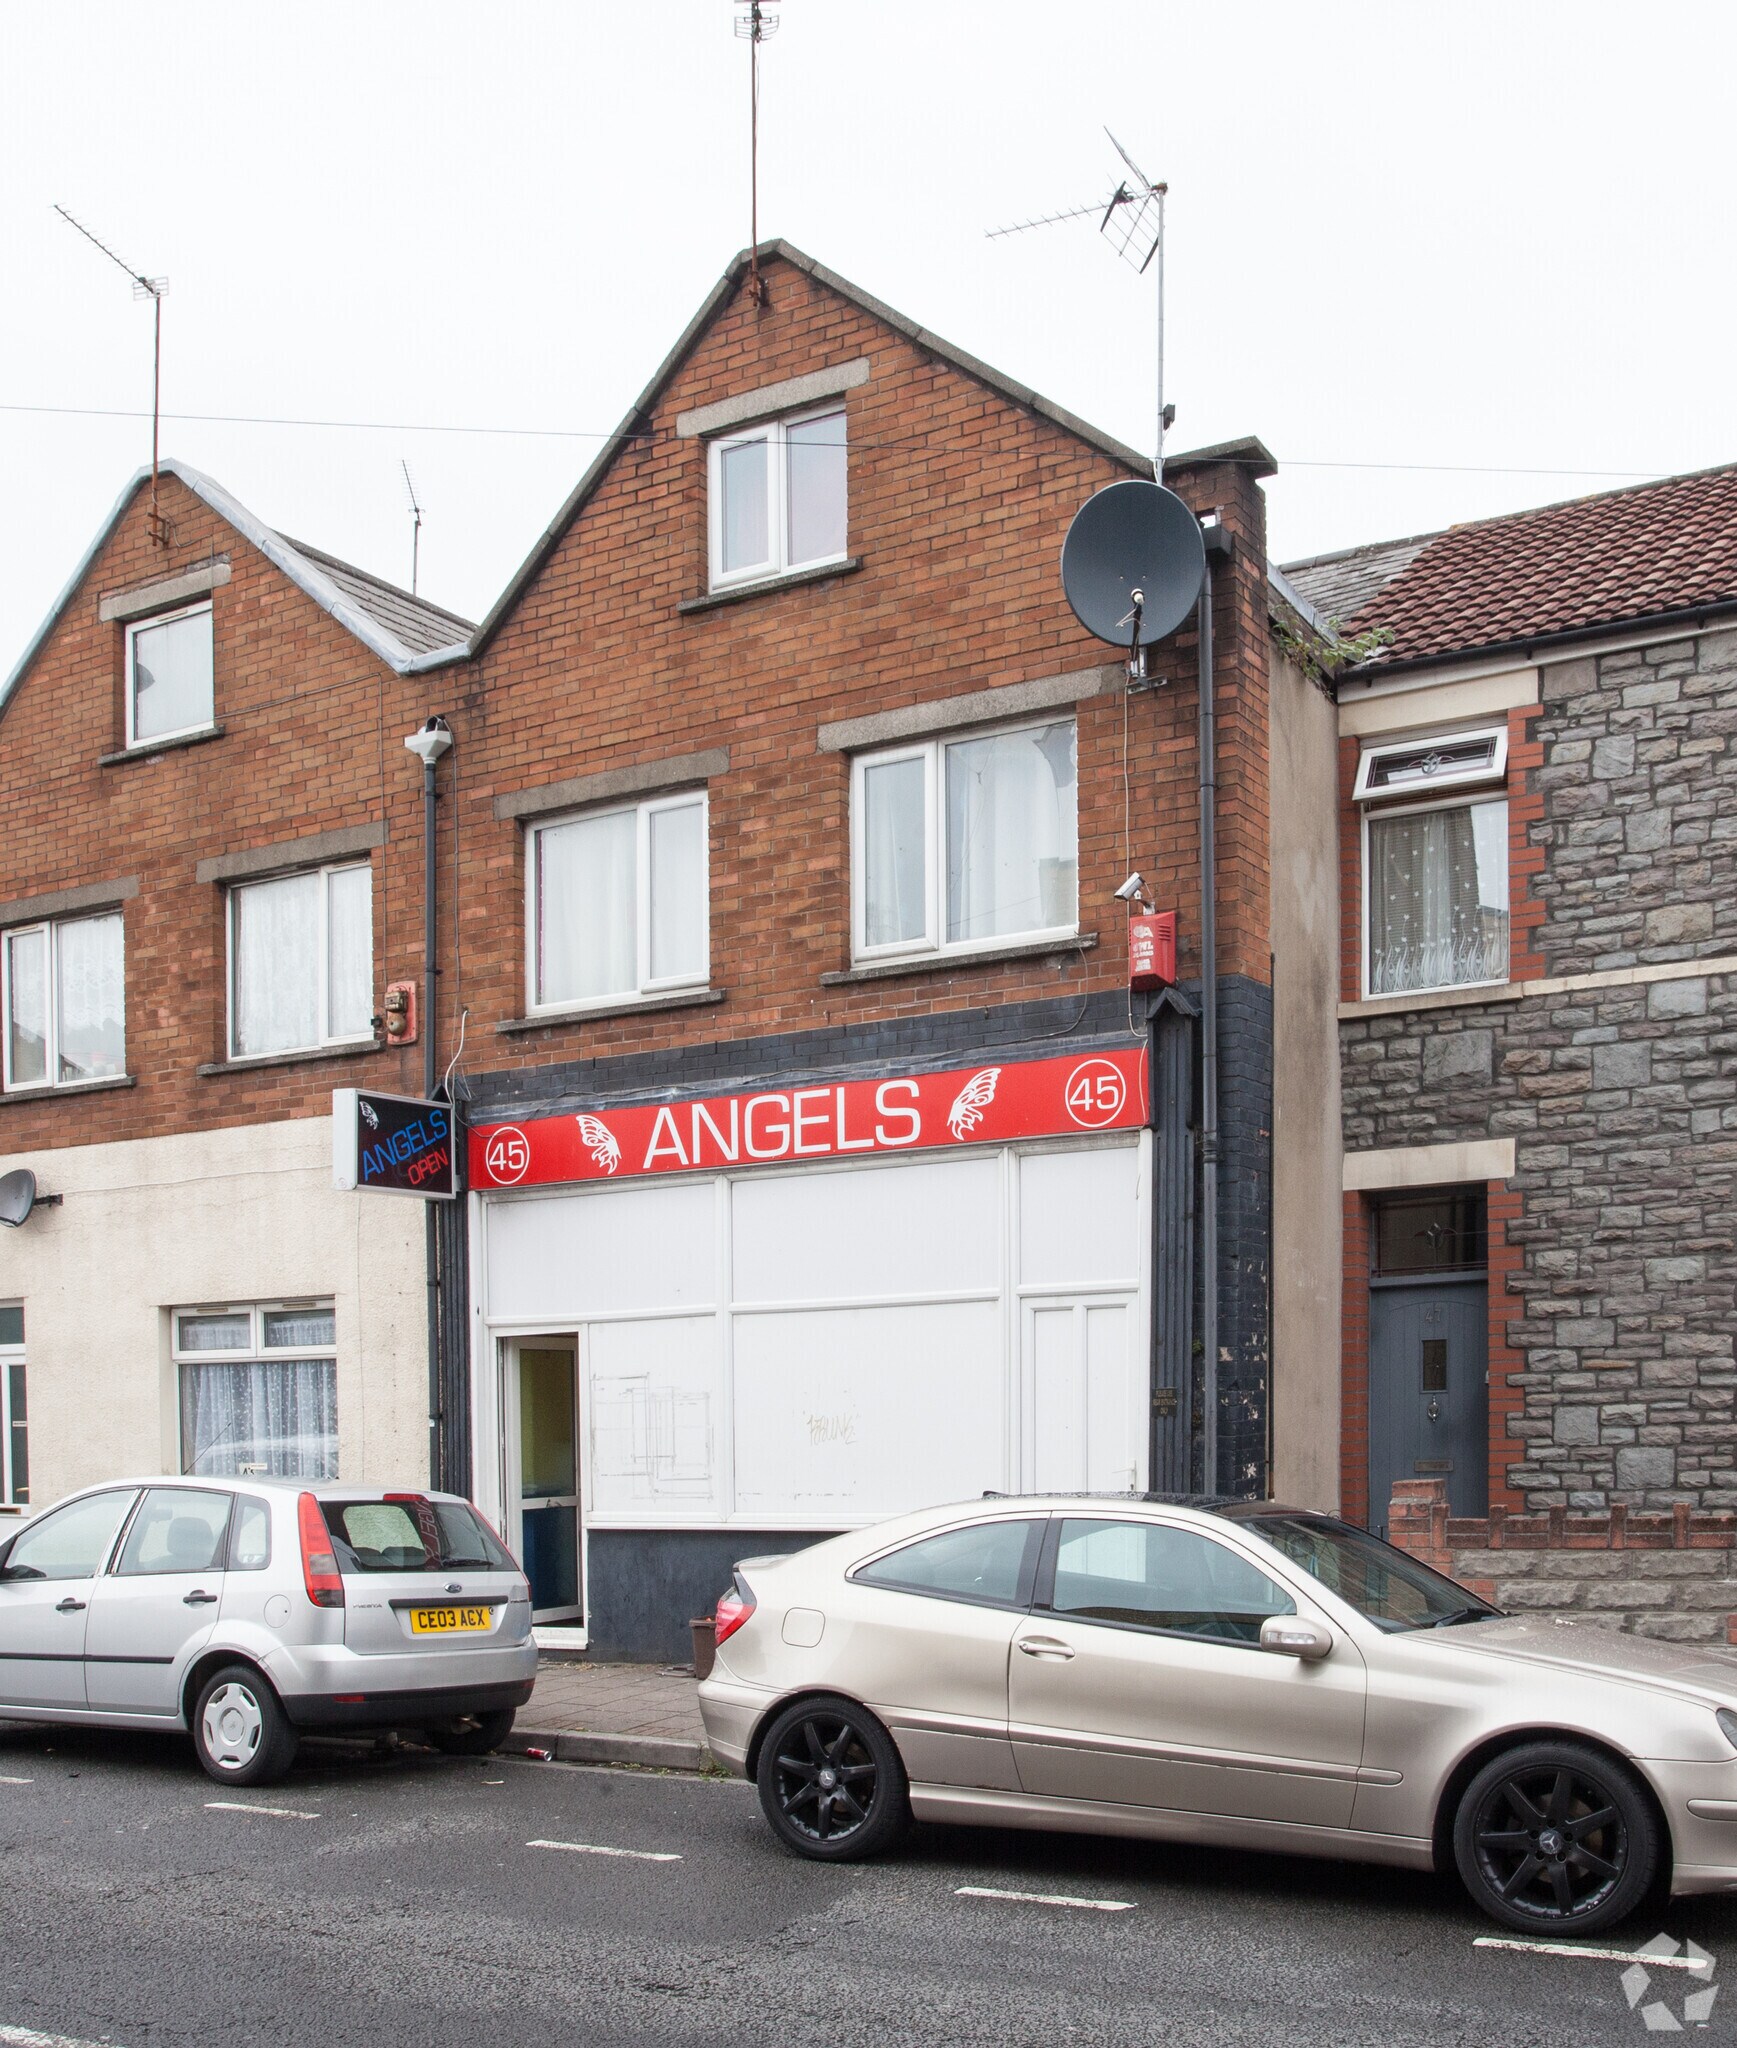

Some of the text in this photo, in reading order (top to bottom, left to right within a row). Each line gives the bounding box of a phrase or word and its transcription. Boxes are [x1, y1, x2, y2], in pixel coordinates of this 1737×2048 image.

[362, 1109, 448, 1182] ANGELS
[488, 1075, 1119, 1171] 45 ANGELS 45
[407, 1147, 448, 1186] OPEN
[418, 1608, 486, 1629] CE03 ACX
